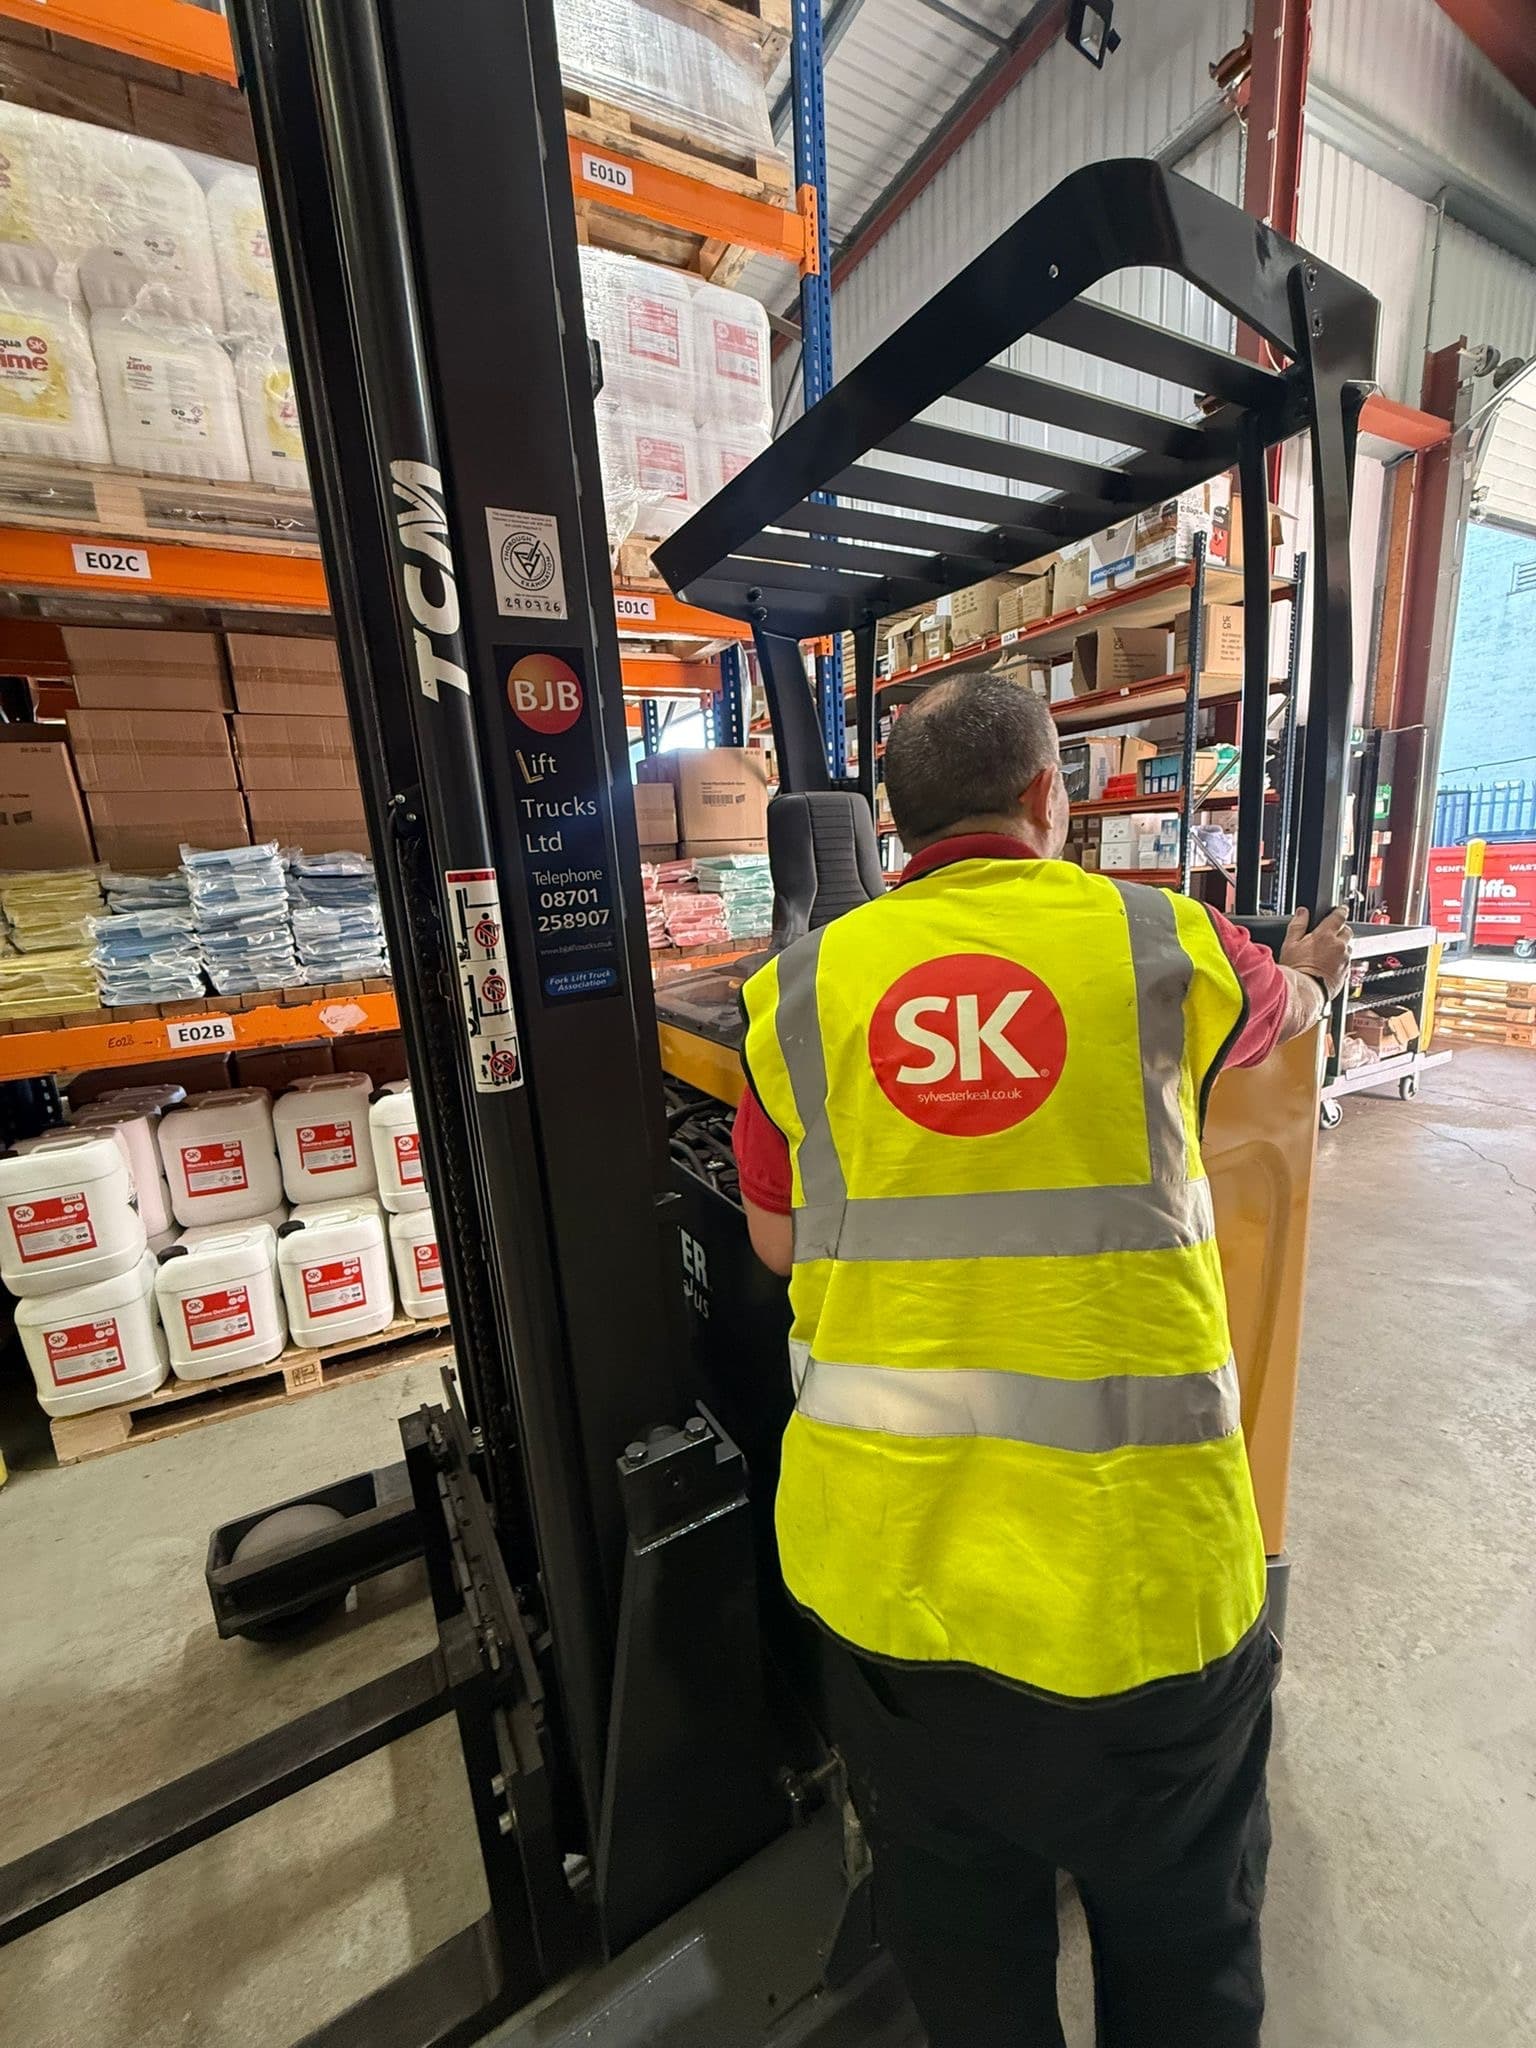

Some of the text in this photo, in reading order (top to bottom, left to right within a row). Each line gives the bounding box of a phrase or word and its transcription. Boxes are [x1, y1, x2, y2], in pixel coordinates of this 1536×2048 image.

[590, 161, 626, 186] E01D
[504, 535, 532, 561] THOROUGH
[85, 552, 140, 572] E02C
[520, 556, 553, 588] EXAMINATION
[389, 459, 471, 702] TCM
[616, 600, 650, 615] E01C
[514, 680, 580, 711] BJB
[515, 750, 558, 784] Lift
[521, 796, 597, 819] Trucks
[526, 831, 562, 853] Ltd
[532, 868, 603, 887] Telephone
[540, 888, 598, 909] 08701
[538, 909, 610, 932] 258907
[550, 970, 610, 986] Fork Lift Truck
[558, 978, 607, 992] Association
[178, 1024, 225, 1043] E02B
[895, 990, 1041, 1084] SK
[917, 1088, 1022, 1104] sylvesterkeal.co.uk
[16, 1209, 32, 1219] SK
